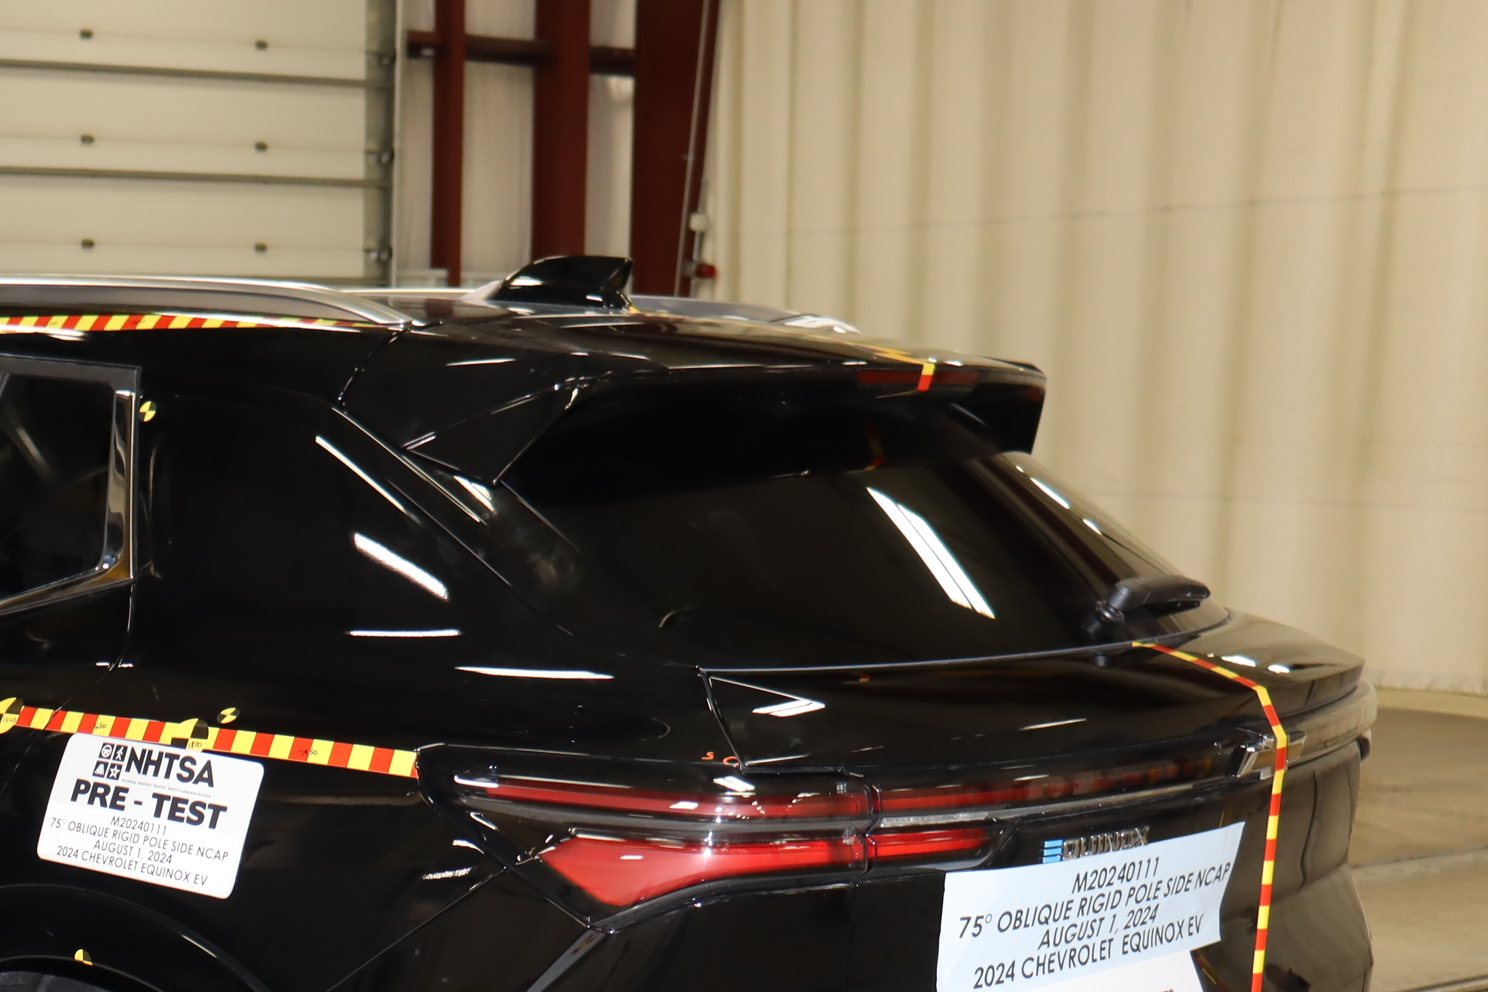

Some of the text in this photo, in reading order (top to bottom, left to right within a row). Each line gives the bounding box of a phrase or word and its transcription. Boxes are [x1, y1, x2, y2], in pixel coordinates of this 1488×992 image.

[124, 746, 214, 788] NHTSA
[70, 778, 129, 811] PRE
[151, 792, 228, 830] TEST
[68, 820, 110, 838] OBLIQUE
[111, 829, 140, 845] RIGID
[143, 835, 169, 851] POLE
[171, 840, 194, 855] SIDE
[197, 846, 229, 863] NCAP
[109, 815, 168, 837] M20240111
[1040, 825, 1150, 864] EQUINOX
[56, 845, 208, 887] 2024 CHEVROLET EQUINOX EV
[93, 839, 135, 859] AUGUST
[142, 850, 173, 865] 2024
[1071, 856, 1160, 894] M20240111
[997, 901, 1074, 933] OBLIQUE
[1076, 890, 1123, 918] RIGID
[1125, 880, 1163, 907] POLE
[1163, 871, 1194, 898] SIDE
[1194, 861, 1232, 891] NCAP
[1037, 914, 1106, 950] AUGUST
[1123, 903, 1160, 931] 2024
[973, 913, 1205, 989] 2024 CHEVROLET EQUINOX EV
